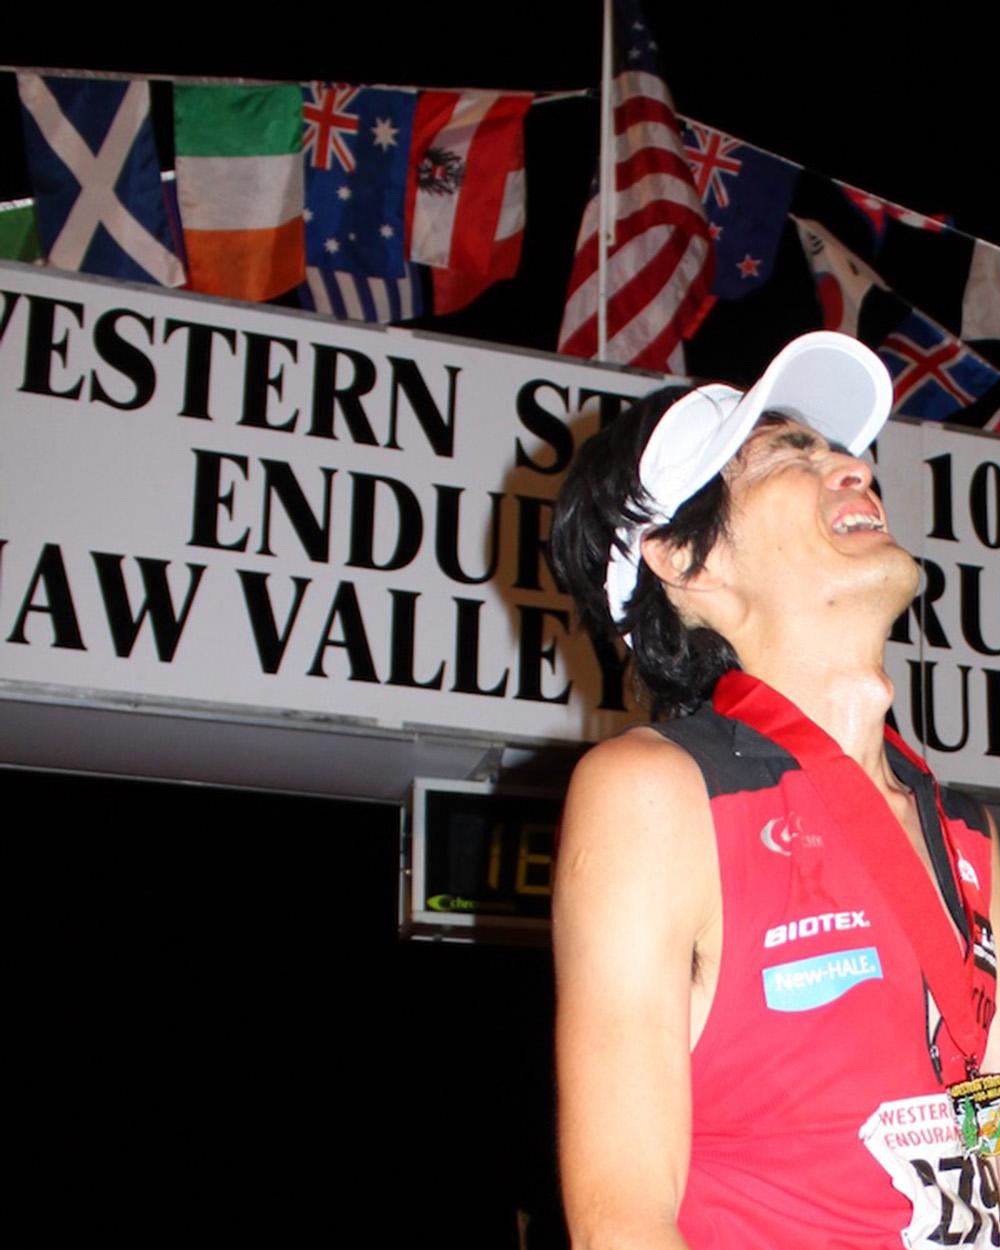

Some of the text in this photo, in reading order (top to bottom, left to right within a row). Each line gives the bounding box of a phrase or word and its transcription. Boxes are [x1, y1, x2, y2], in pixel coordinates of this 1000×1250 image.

[187, 447, 567, 595] ENDUR
[0, 540, 207, 663] AW
[880, 1103, 953, 1126] WESTER
